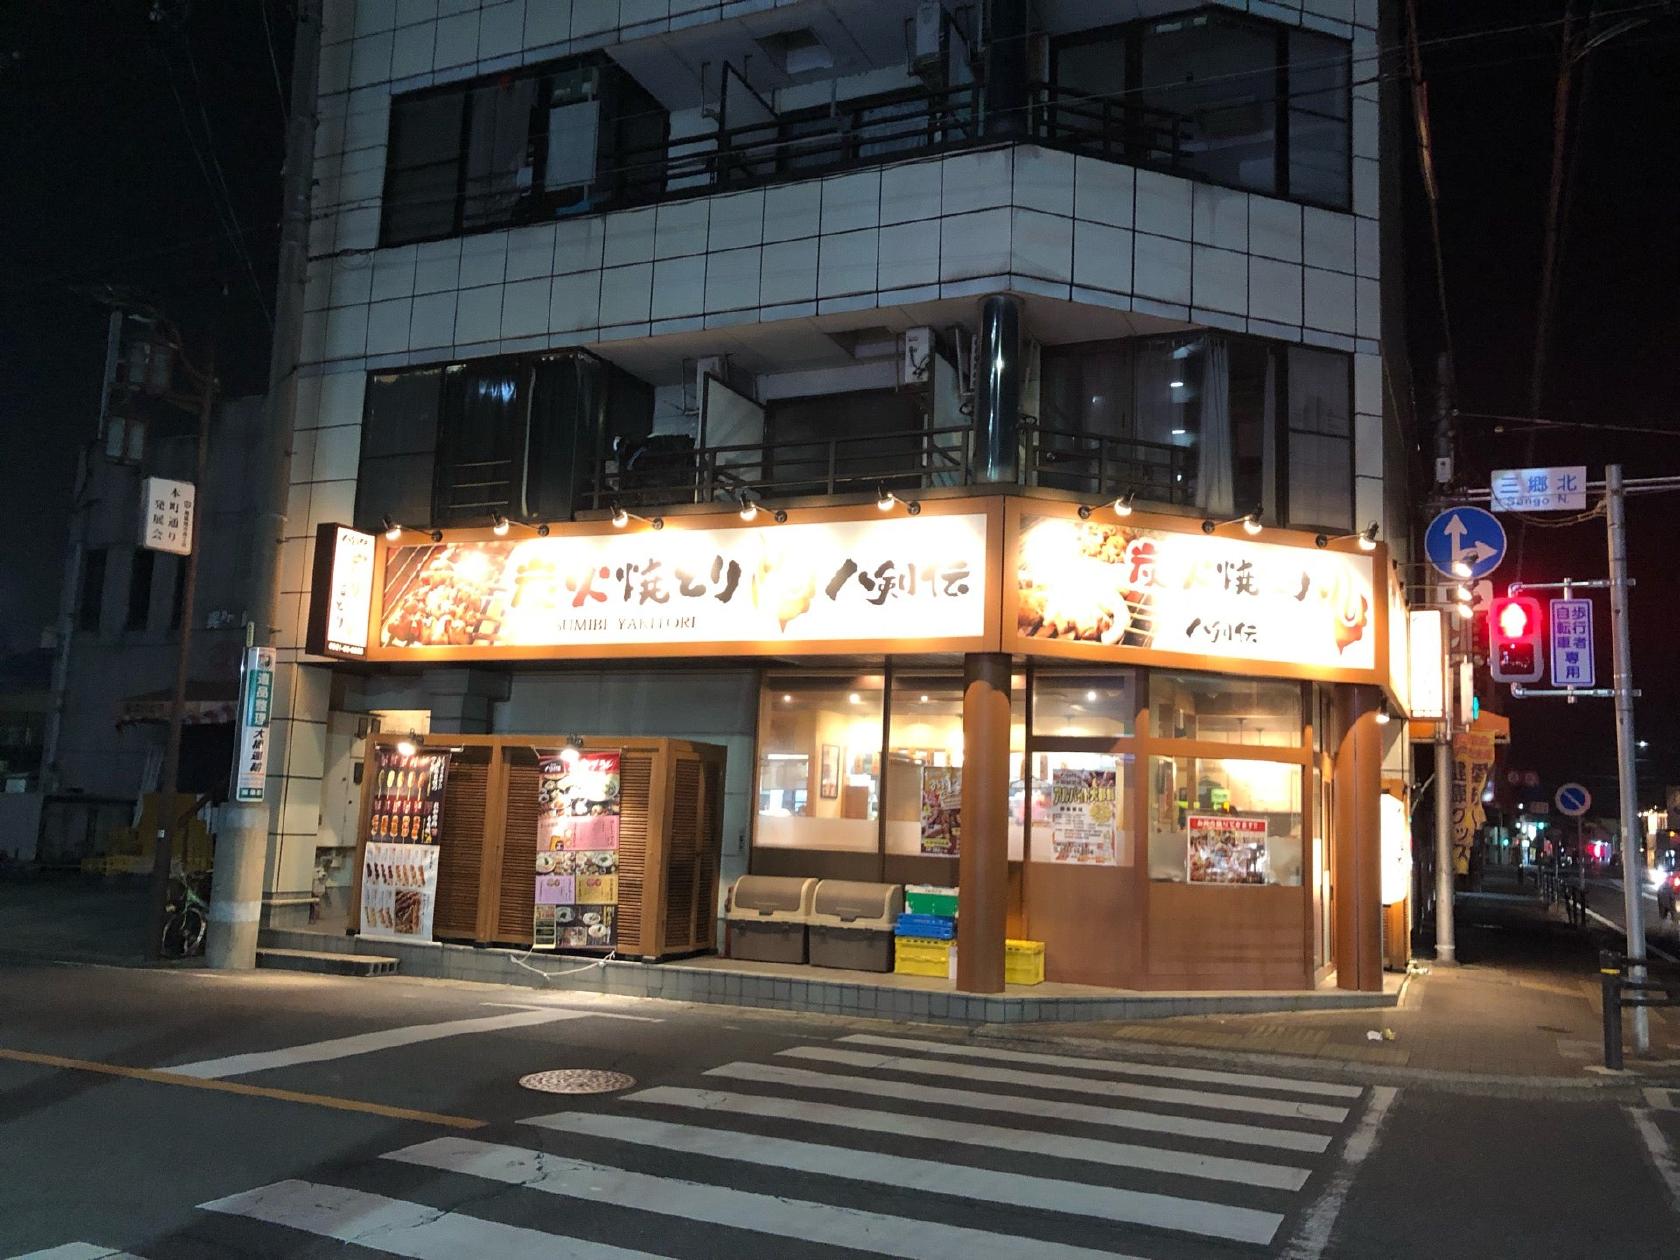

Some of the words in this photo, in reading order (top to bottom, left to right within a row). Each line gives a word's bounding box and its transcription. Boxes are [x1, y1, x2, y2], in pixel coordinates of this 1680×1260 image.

[1500, 474, 1577, 493] 三郷北
[1507, 496, 1550, 507] Sango
[168, 487, 181, 541] 本町通り
[826, 556, 971, 605] 八剣伝
[1557, 607, 1571, 649] 自転車
[1572, 606, 1587, 649] 歩行者
[1565, 651, 1580, 679] 専用
